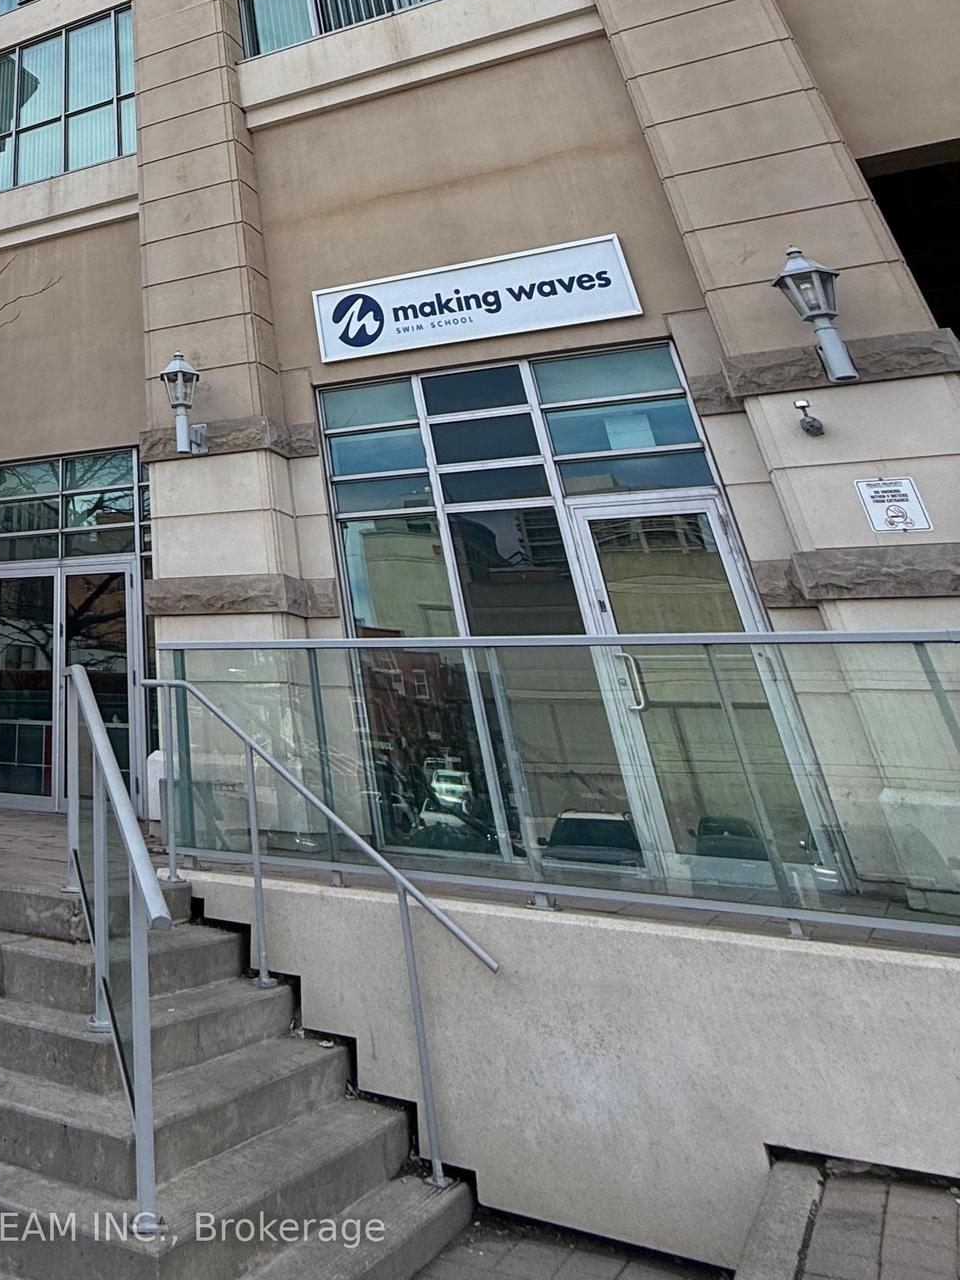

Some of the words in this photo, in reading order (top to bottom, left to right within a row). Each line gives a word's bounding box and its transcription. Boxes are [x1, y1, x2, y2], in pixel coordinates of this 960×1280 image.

[392, 289, 502, 323] making
[505, 270, 612, 302] waves
[396, 324, 424, 334] SWIM
[430, 316, 474, 329] SCHOOL
